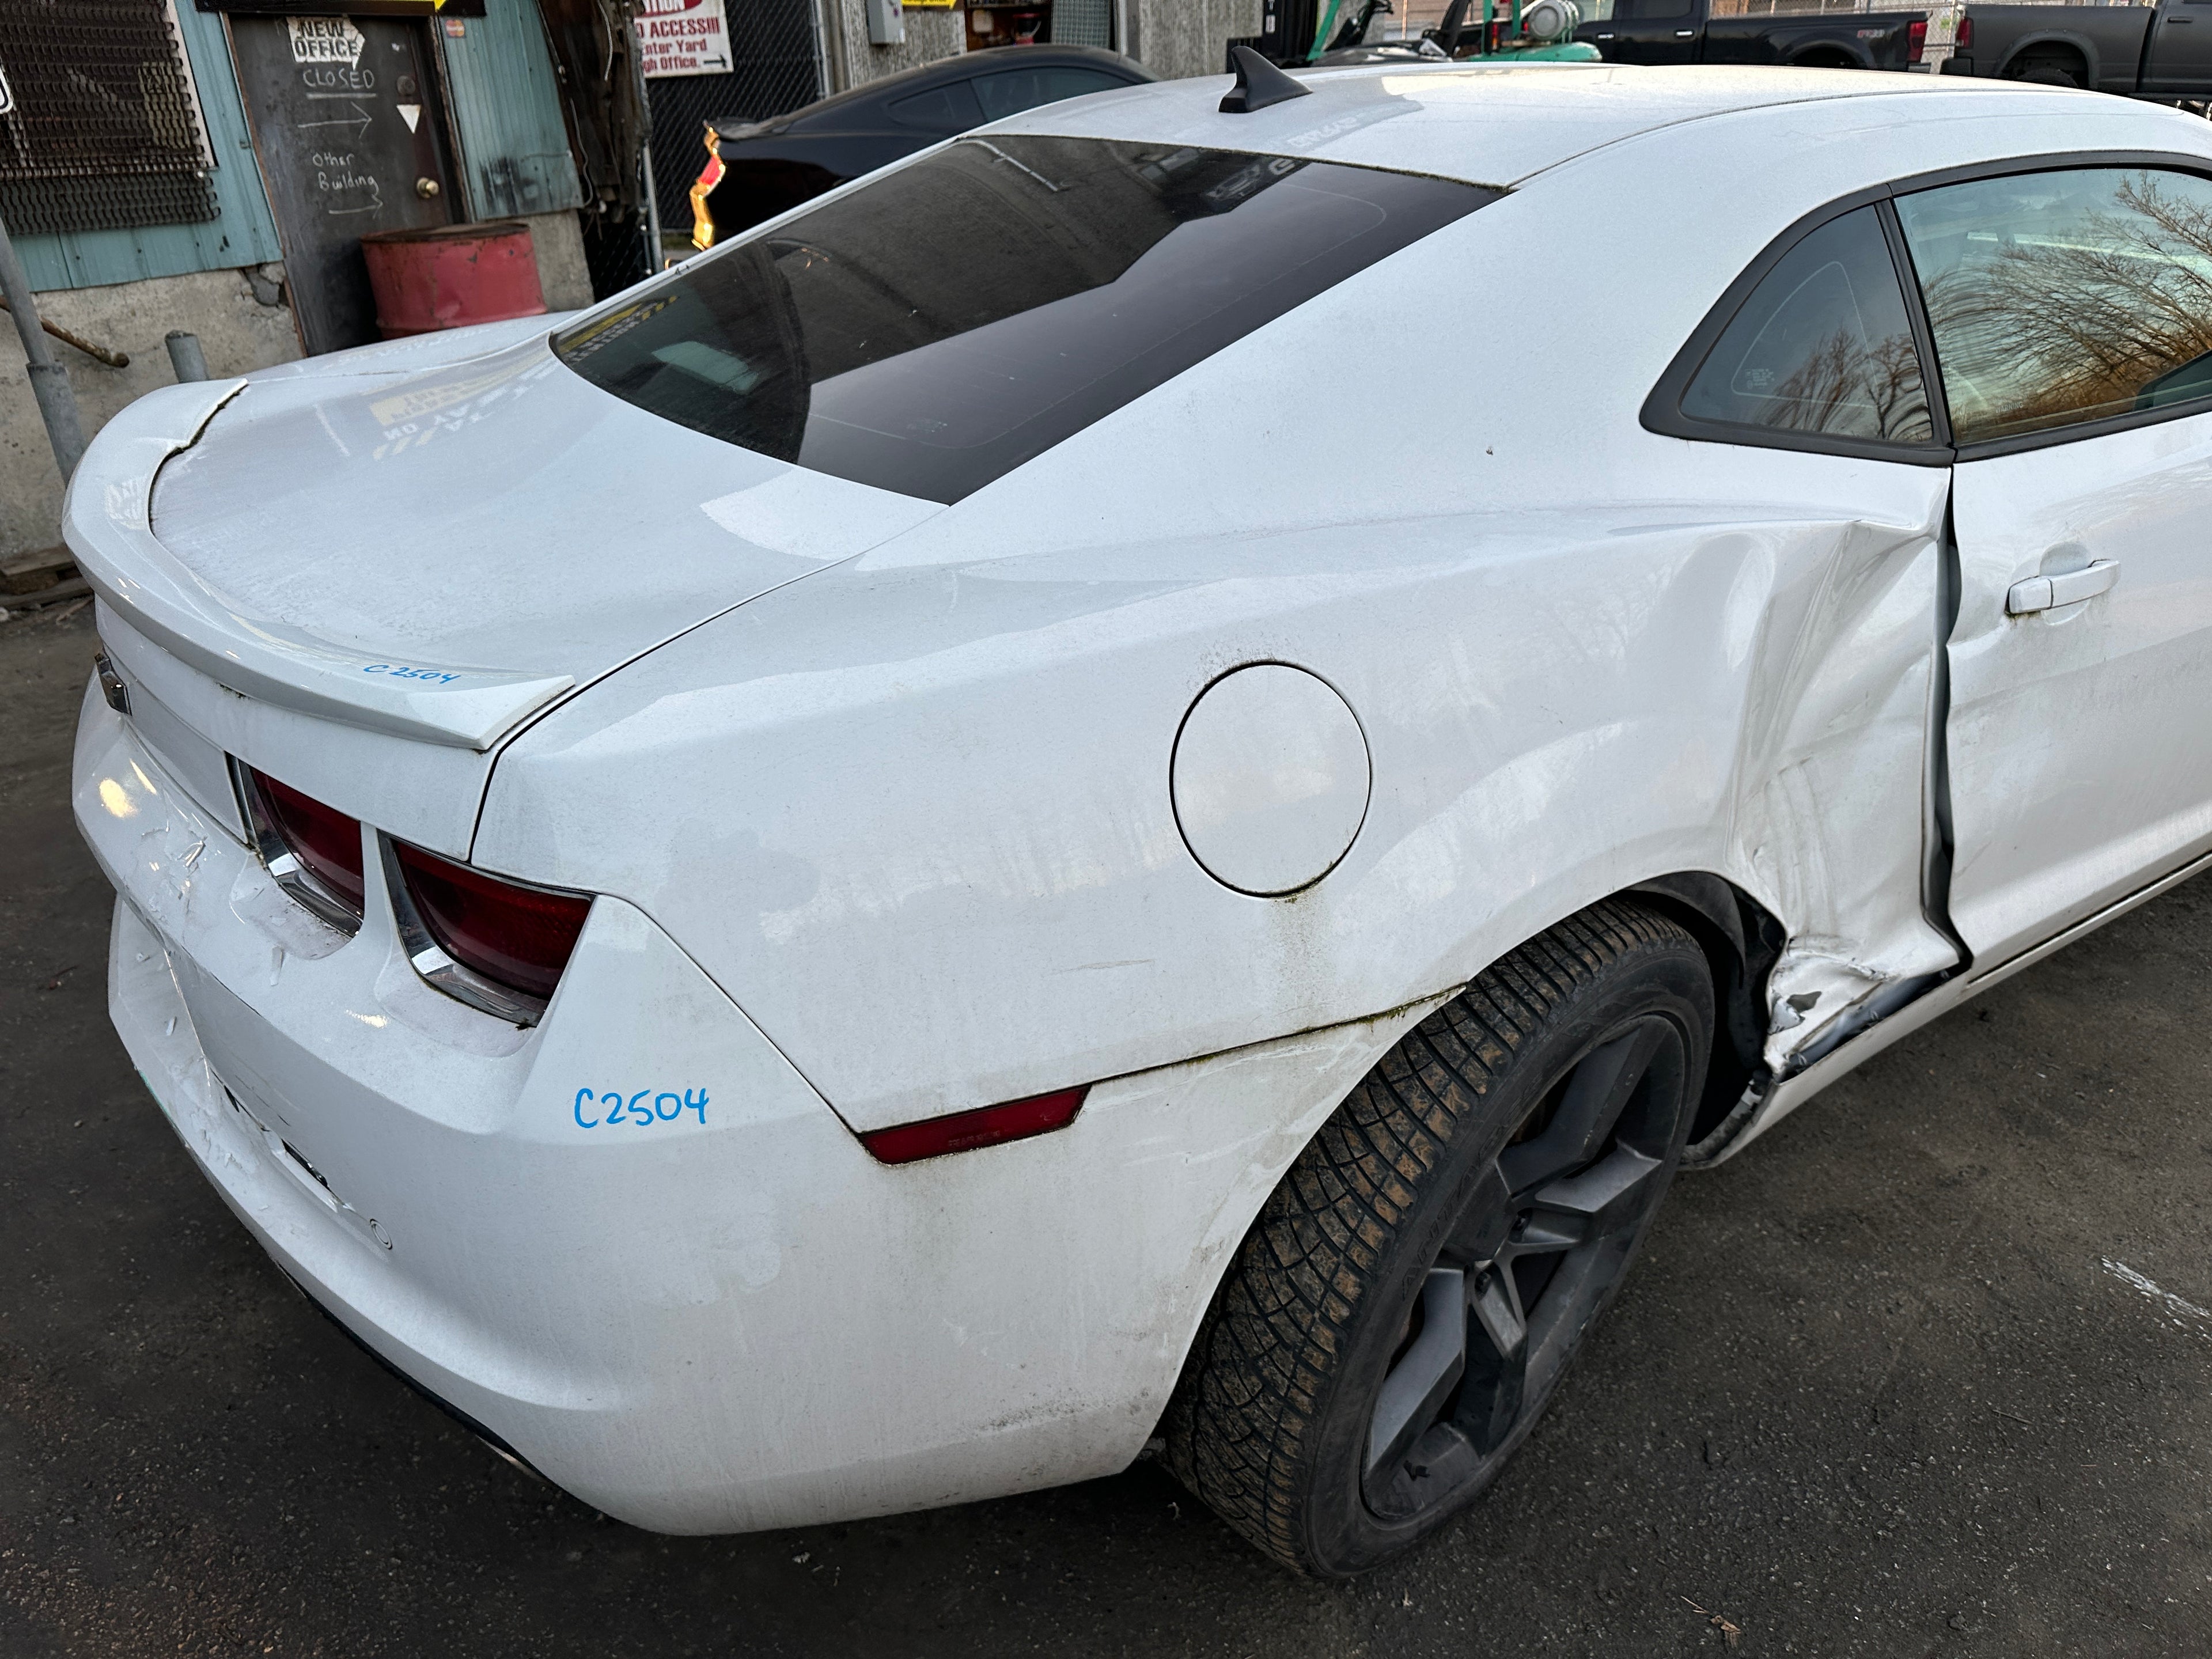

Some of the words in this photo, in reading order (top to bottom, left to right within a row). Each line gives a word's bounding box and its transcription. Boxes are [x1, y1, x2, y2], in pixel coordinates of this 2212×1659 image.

[299, 20, 345, 37] NEW
[295, 39, 358, 56] OFFICE
[676, 39, 707, 53] Yard
[302, 67, 375, 89] CLOSED
[318, 171, 380, 196] Building
[574, 1087, 710, 1128] C2504
